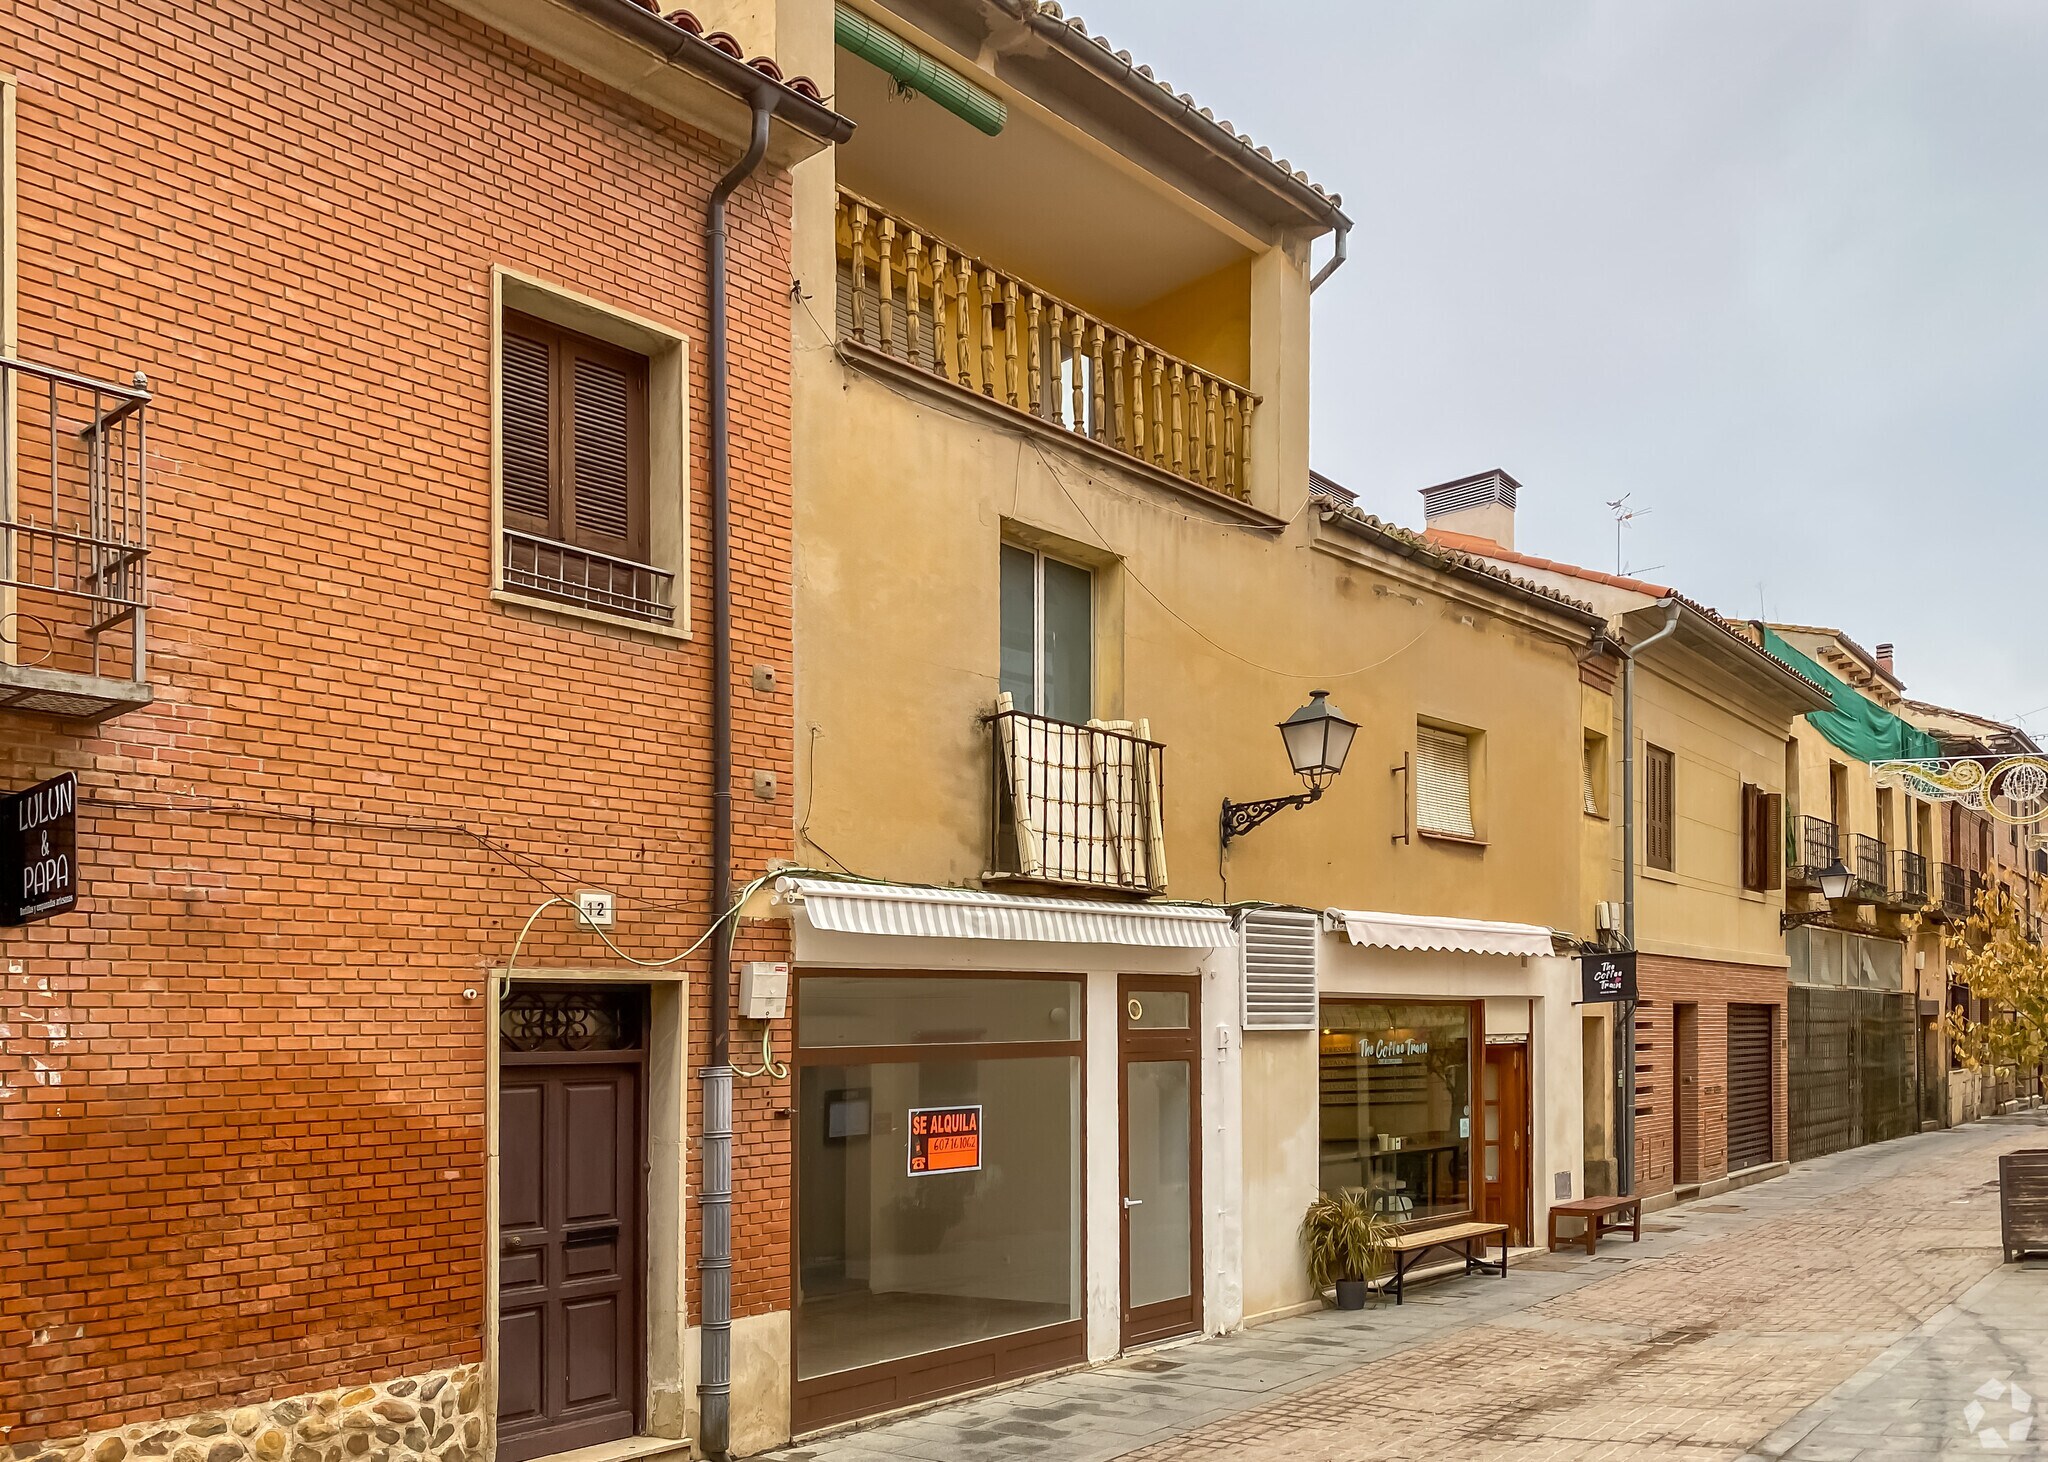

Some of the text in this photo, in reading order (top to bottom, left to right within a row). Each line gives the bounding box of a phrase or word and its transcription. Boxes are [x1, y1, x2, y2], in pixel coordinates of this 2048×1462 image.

[19, 780, 72, 831] LULUN
[41, 829, 50, 857] &
[24, 853, 69, 899] PAPA
[1593, 970, 1623, 981] Coffee
[1600, 961, 1615, 971] The
[1599, 980, 1622, 990] Train
[1358, 1038, 1428, 1059] The Coffee Train
[912, 1113, 977, 1135] SE ALQUILA
